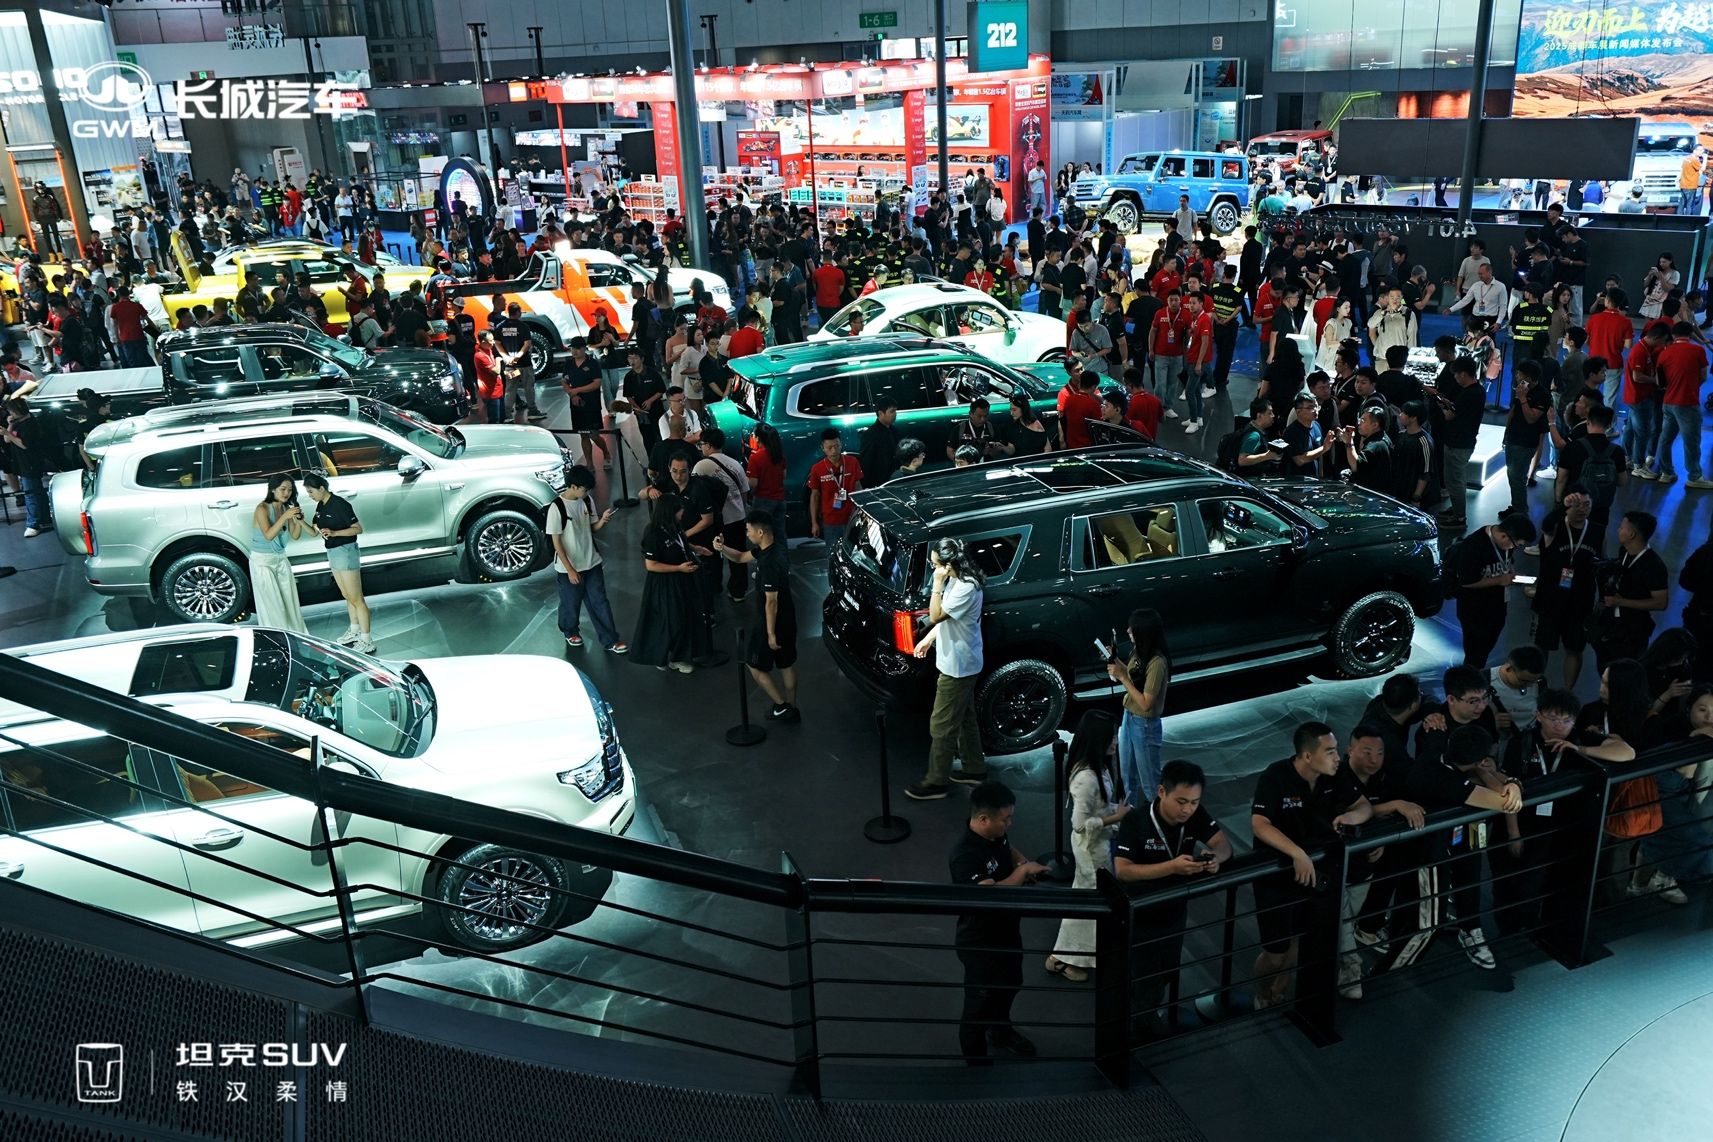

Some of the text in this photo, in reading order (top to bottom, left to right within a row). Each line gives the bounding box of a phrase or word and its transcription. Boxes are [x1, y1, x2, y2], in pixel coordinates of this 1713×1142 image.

[863, 15, 880, 26] 1-6
[1543, 2, 1713, 38] 迎刃而上 为越
[986, 22, 1018, 48] 212
[4, 92, 79, 105] MOTORCLE
